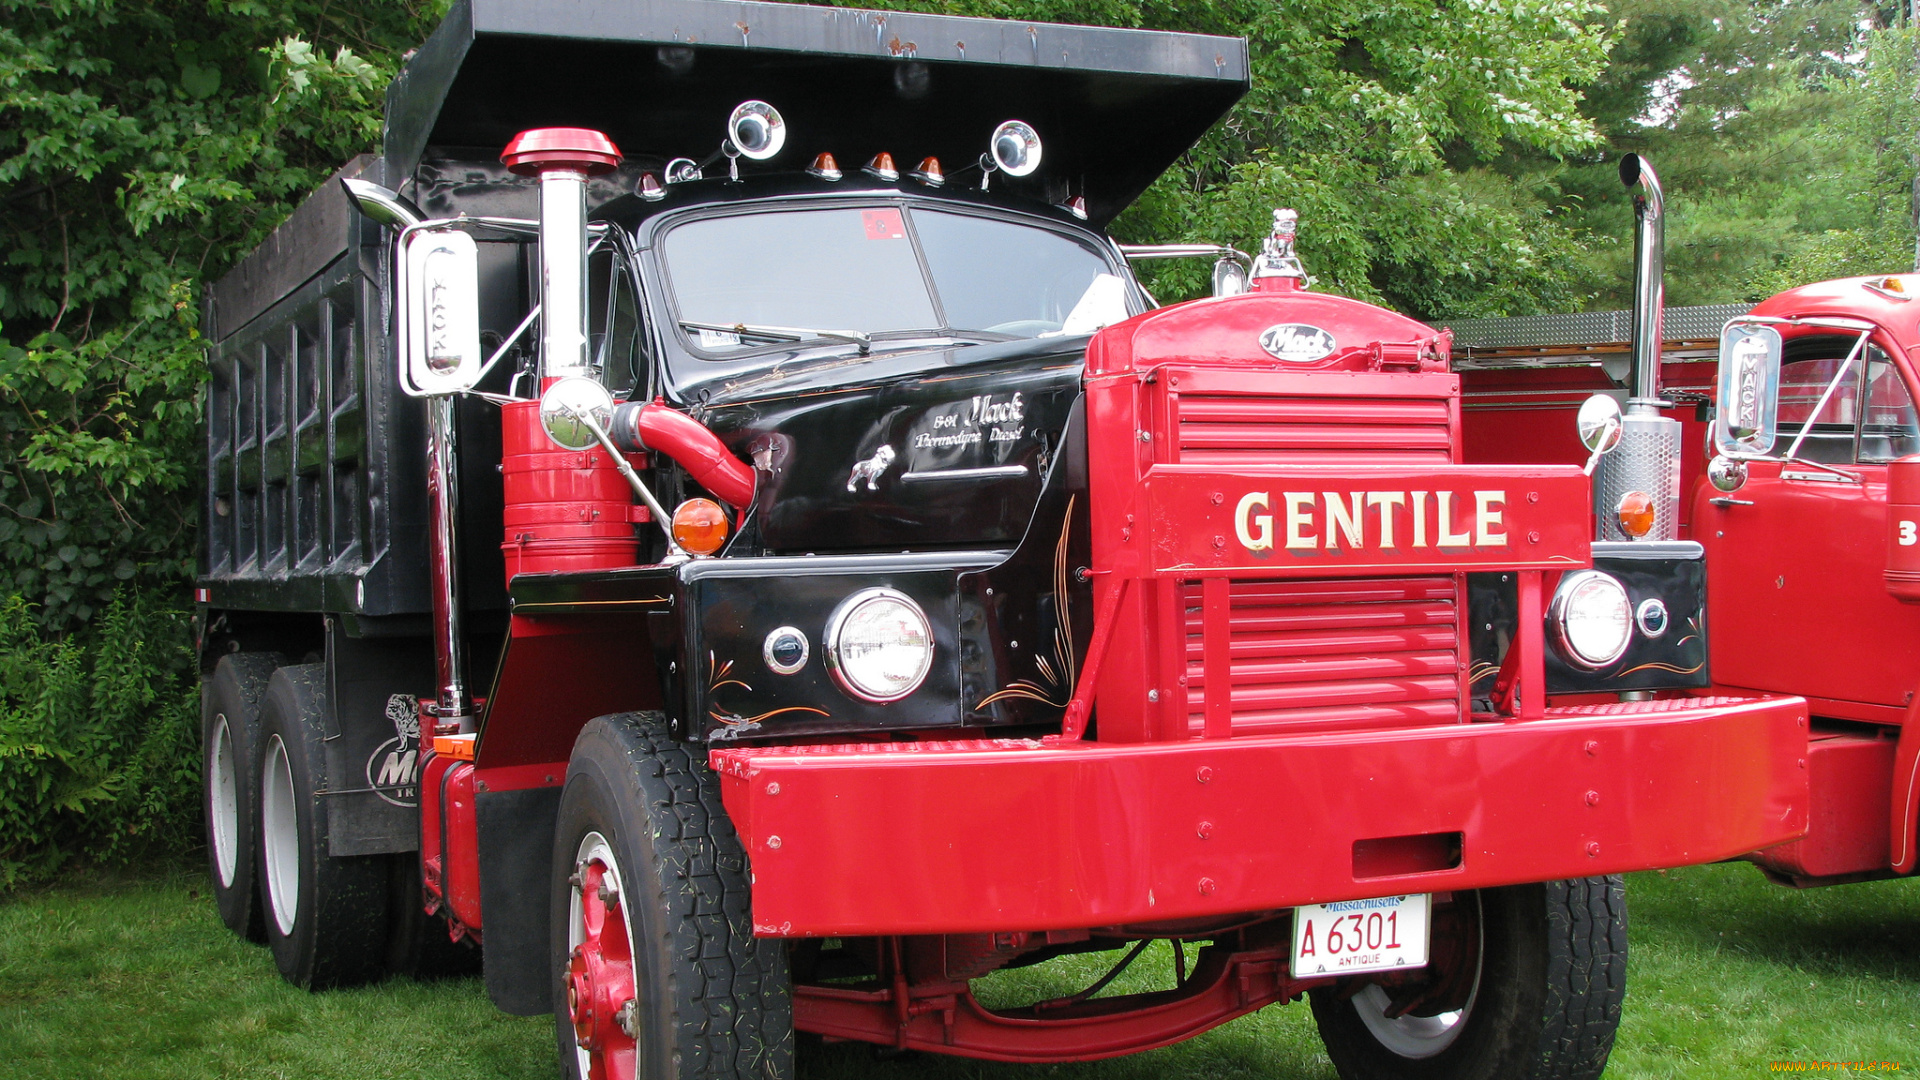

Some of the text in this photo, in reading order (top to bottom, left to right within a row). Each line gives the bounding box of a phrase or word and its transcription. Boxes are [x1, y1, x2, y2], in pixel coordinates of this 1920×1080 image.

[1268, 326, 1329, 354] Mack
[1740, 358, 1758, 421] MACK
[964, 391, 1025, 427] Mack
[915, 425, 1025, 452] Thermodyne Diesel
[1234, 489, 1508, 552] GENTILE
[1897, 520, 1918, 546] 3
[377, 749, 418, 786] M
[1326, 896, 1401, 913] Massachusetts
[1300, 910, 1401, 958] A 6301
[1338, 953, 1381, 967] ANTIQUE
